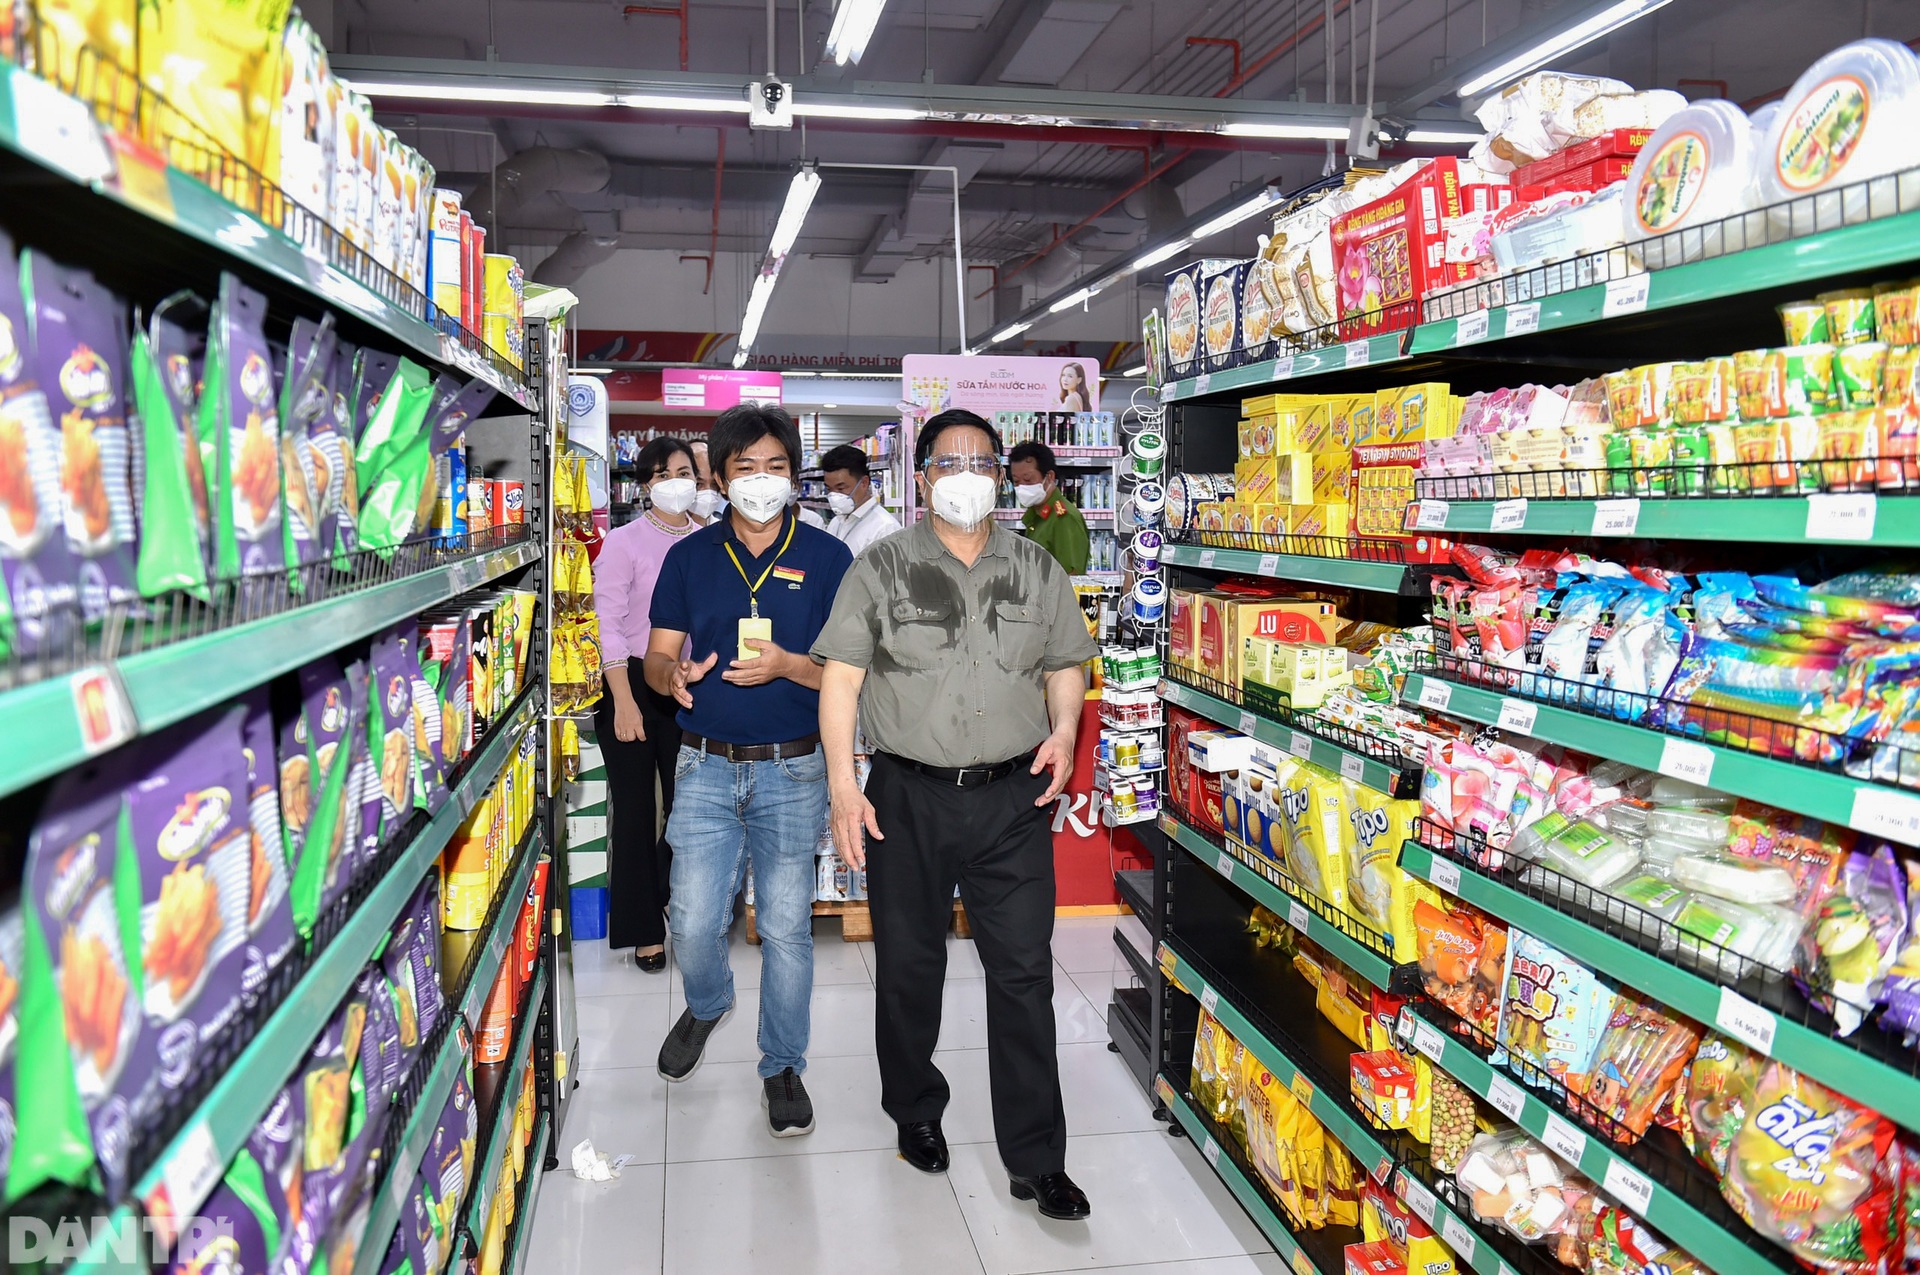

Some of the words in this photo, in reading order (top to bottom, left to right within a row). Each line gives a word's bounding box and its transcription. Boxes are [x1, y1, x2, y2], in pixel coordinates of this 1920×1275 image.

[747, 354, 777, 366] GIAO
[780, 352, 818, 366] HÀNG
[822, 351, 855, 366] MIỄN
[859, 354, 881, 367] PHÍ
[956, 379, 976, 389] SỮA
[999, 380, 1026, 390] NƯỚC
[1027, 382, 1048, 390] HOA
[1260, 614, 1278, 635] LU
[1350, 807, 1389, 847] Tipo
[1700, 1068, 1725, 1093] Jelly
[1249, 1077, 1272, 1108] BUTTER
[1423, 1261, 1452, 1275] Tipo
